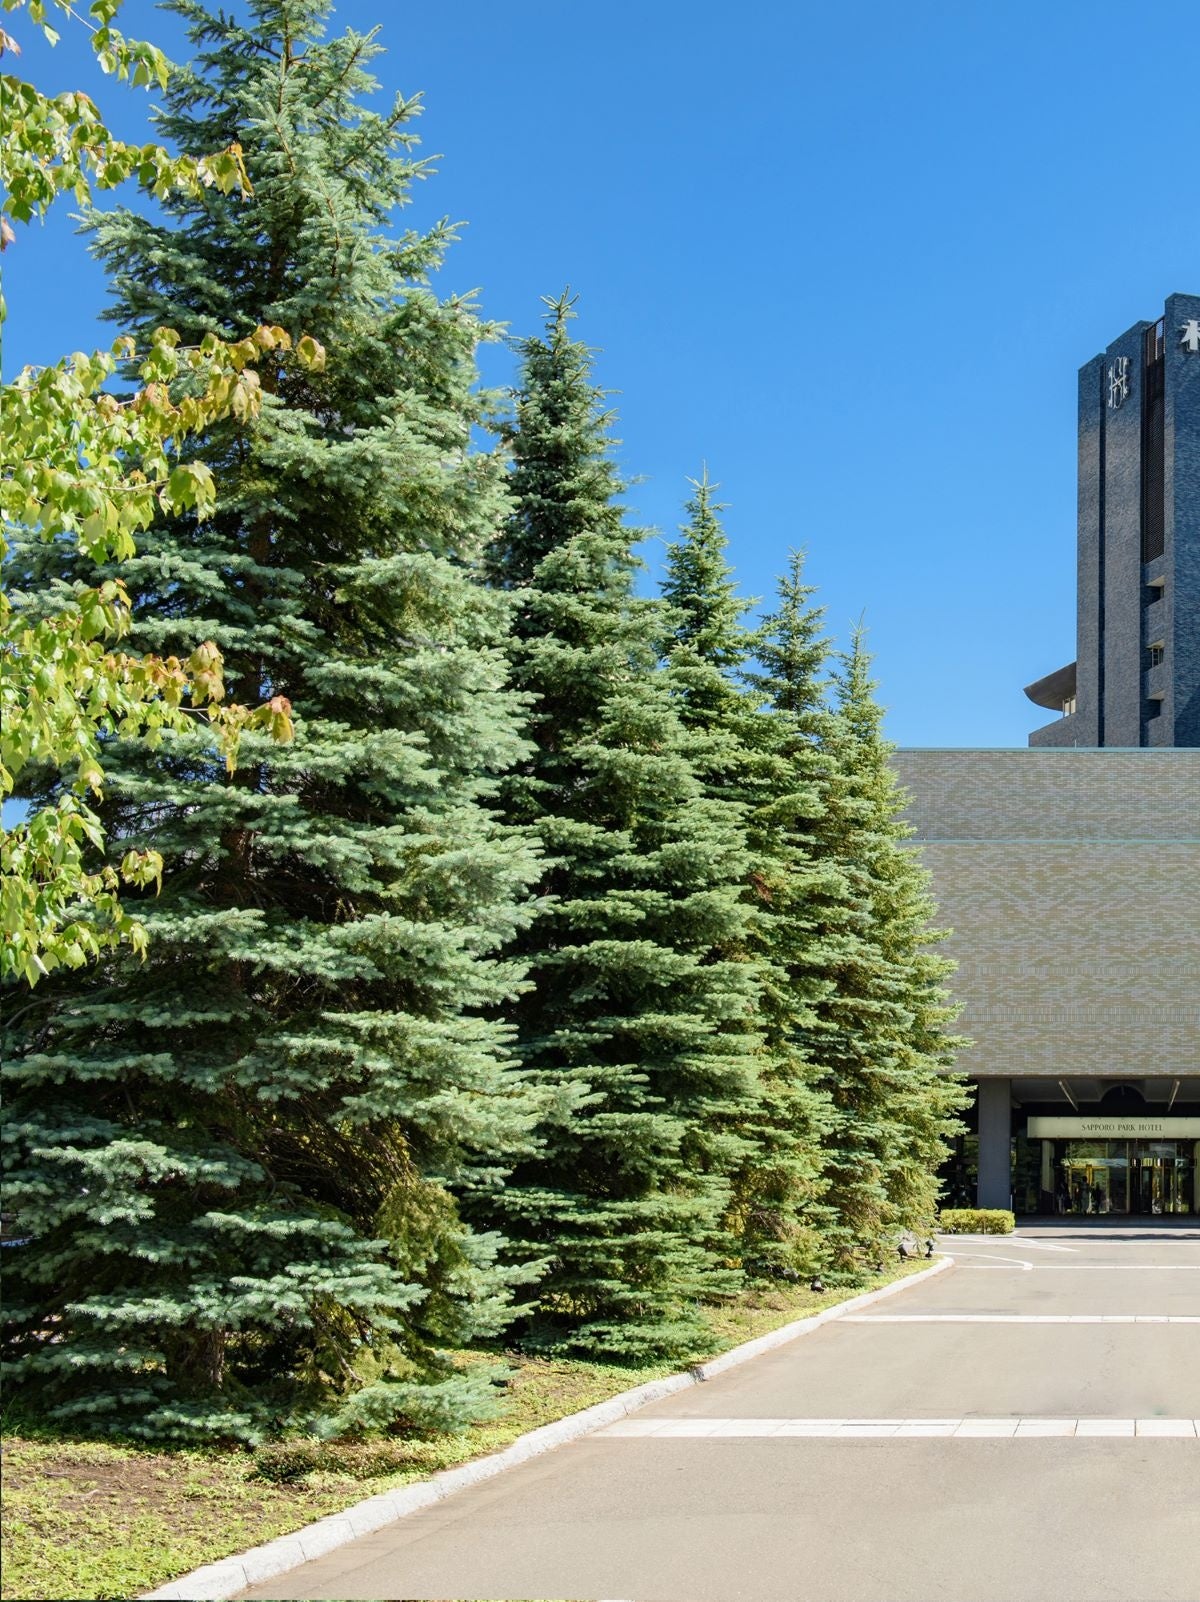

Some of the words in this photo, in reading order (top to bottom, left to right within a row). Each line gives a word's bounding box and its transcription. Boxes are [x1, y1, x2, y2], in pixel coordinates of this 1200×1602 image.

[1081, 1124, 1115, 1132] SAPPORO
[1118, 1124, 1135, 1132] PARK
[1138, 1124, 1163, 1132] HOTEL
